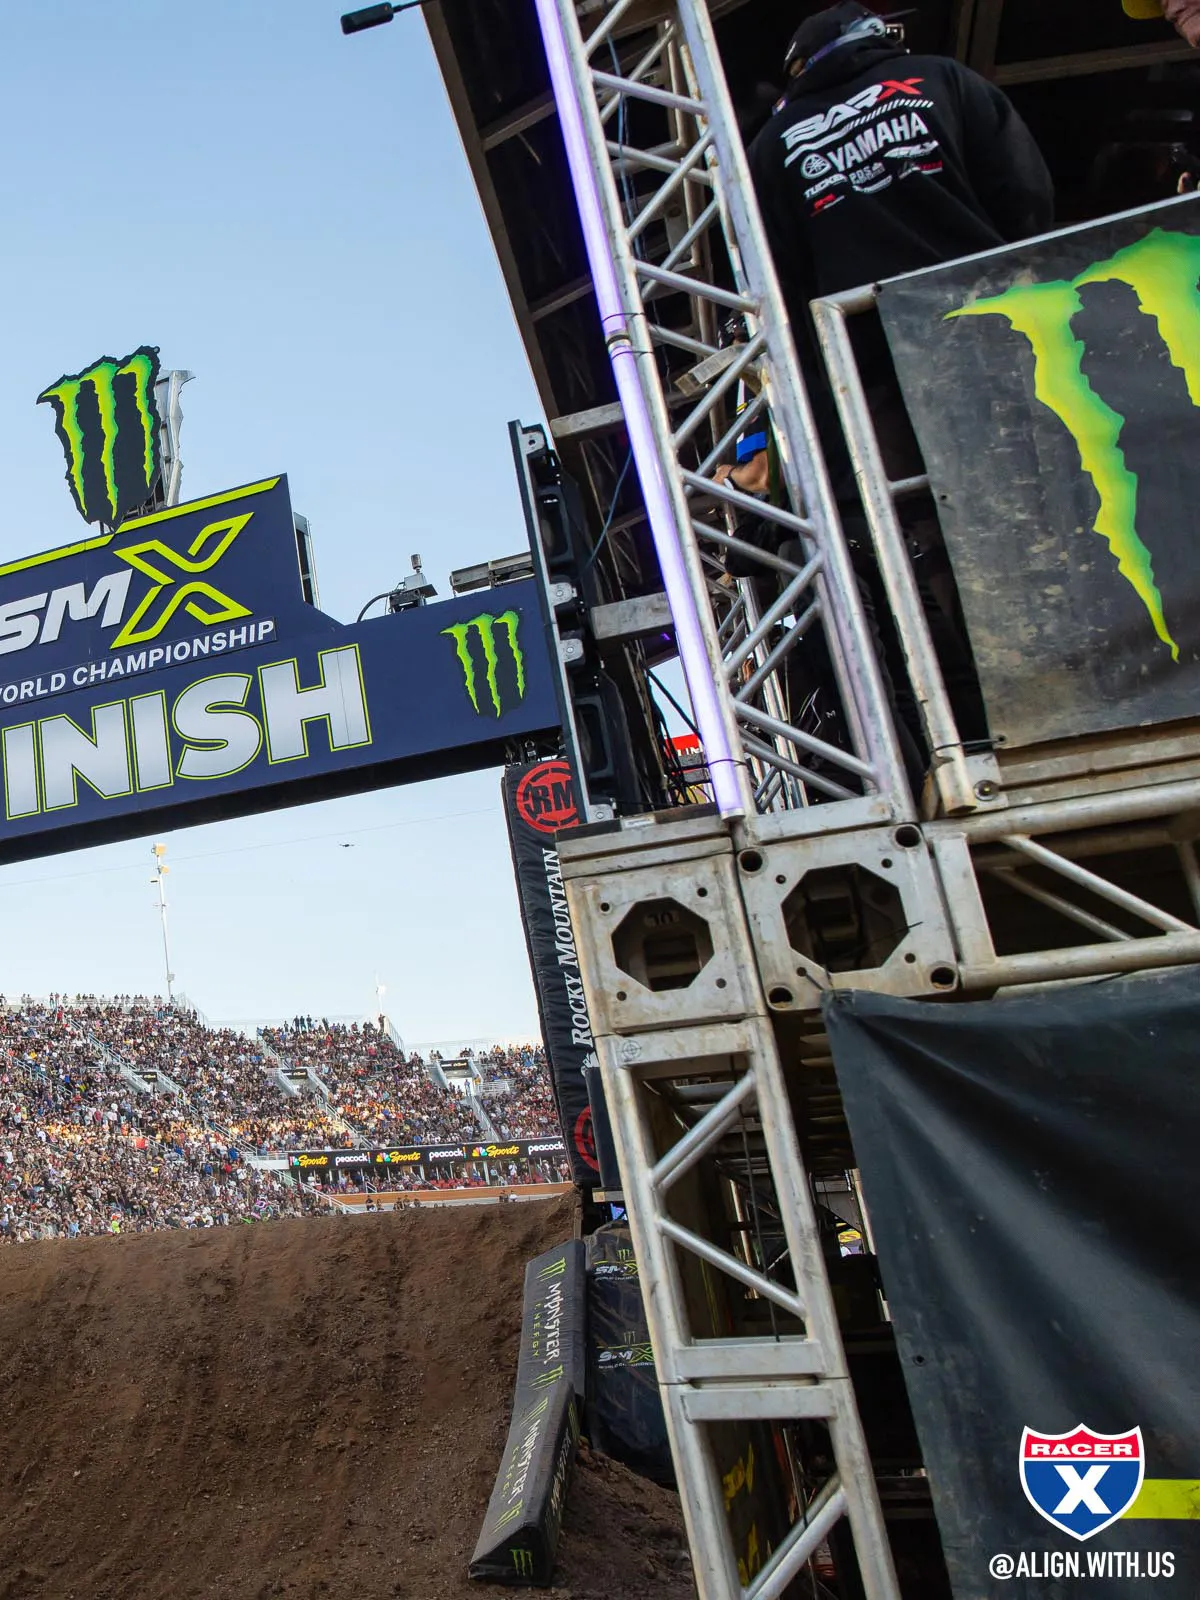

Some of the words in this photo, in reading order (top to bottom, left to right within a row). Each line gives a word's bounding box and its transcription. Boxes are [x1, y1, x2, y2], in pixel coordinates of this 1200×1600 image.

[827, 112, 929, 173] YAMAHA
[72, 620, 276, 688] CHAMPIONSHIP
[542, 848, 577, 968] MOUNTAIN
[564, 972, 593, 1048] ROCKY
[298, 1154, 328, 1168] Sports
[335, 1152, 368, 1167] peacock
[389, 1151, 421, 1165] Sports
[428, 1147, 464, 1162] peacock
[486, 1143, 520, 1158] Sports
[527, 1141, 565, 1155] peacock
[544, 1281, 564, 1365] MONSTER
